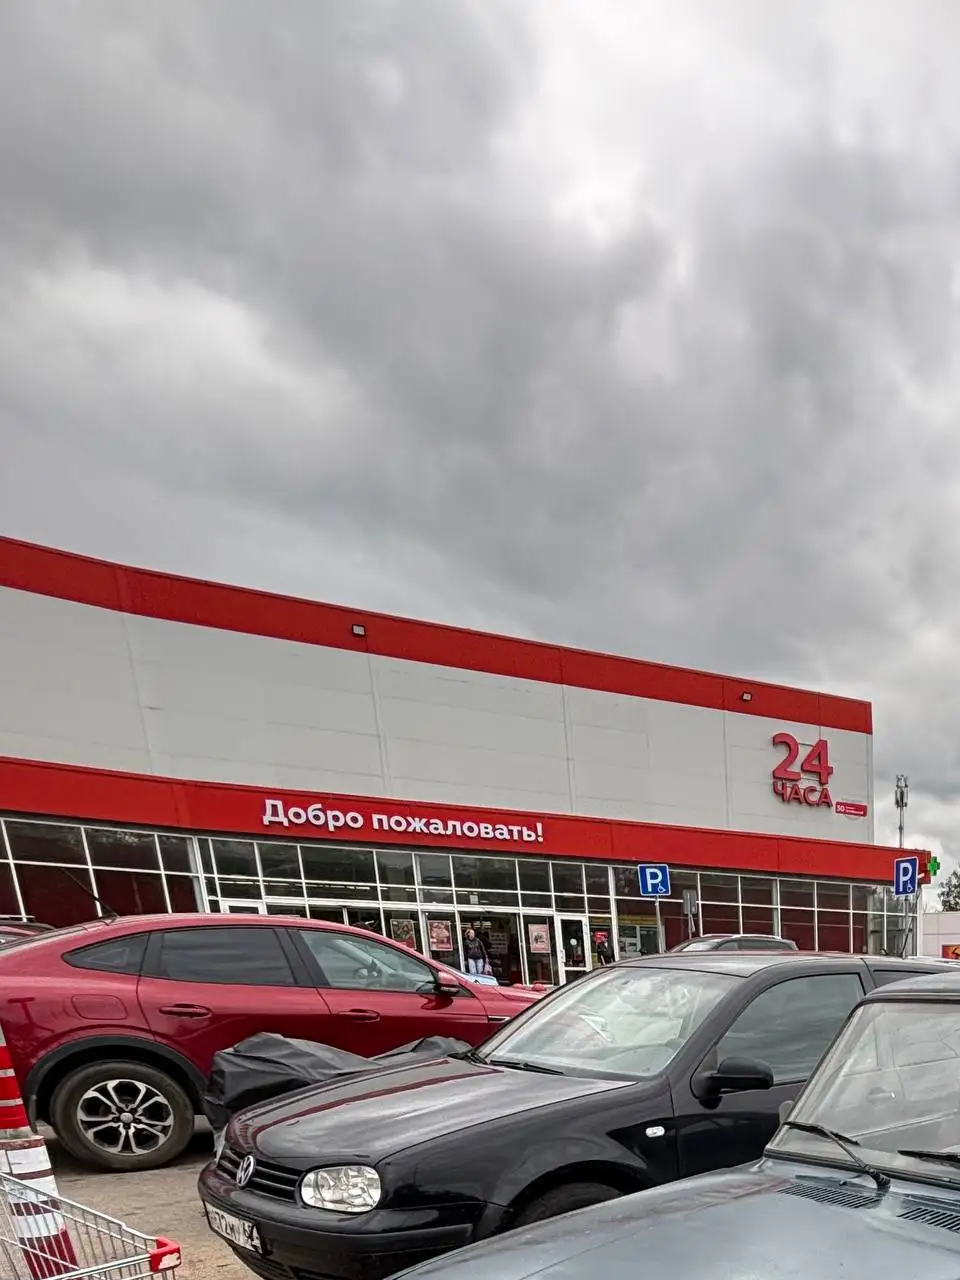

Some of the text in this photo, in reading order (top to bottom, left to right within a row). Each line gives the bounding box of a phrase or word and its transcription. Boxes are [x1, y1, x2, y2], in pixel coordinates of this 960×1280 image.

[772, 732, 833, 786] 24
[772, 780, 833, 808] ЧАСА
[262, 799, 544, 842] Добро пожаловать!
[645, 867, 663, 892] P
[899, 862, 913, 892] P
